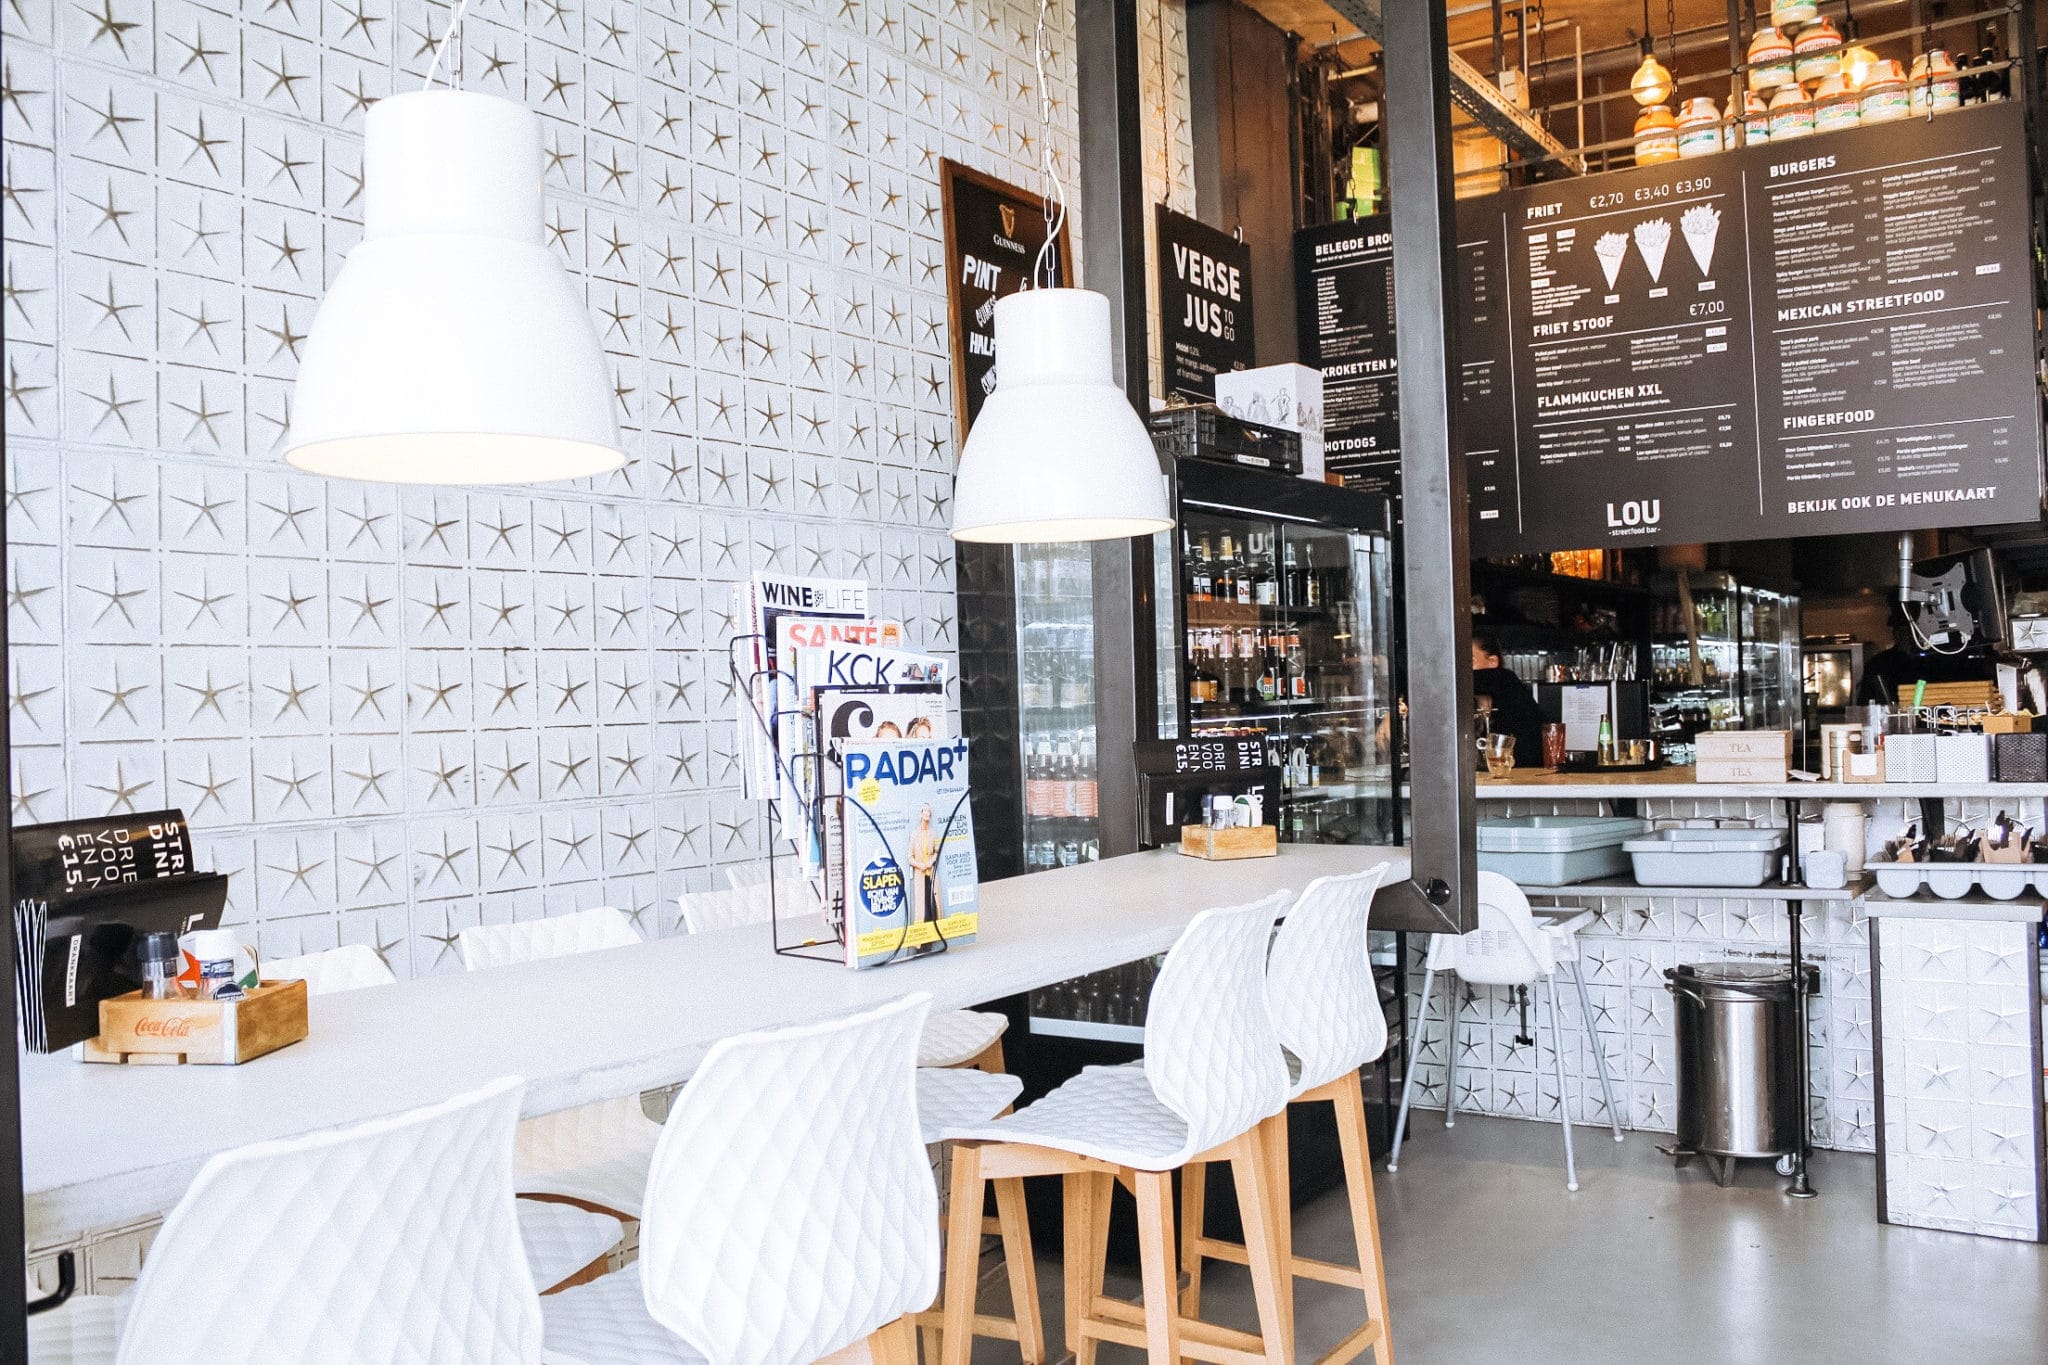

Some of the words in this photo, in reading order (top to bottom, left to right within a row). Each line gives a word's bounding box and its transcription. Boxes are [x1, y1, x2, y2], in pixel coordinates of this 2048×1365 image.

[1770, 156, 1836, 178] BURGERS
[1527, 203, 1562, 219] FRIET
[1590, 192, 1624, 209] €2,70
[1635, 185, 1669, 201] €3,40
[1676, 177, 1712, 194] €3,90
[993, 234, 1025, 254] GUINNESS
[1316, 238, 1364, 256] BELEGDE
[963, 254, 1001, 292] PINT
[1173, 242, 1241, 302] VERSE
[1184, 294, 1222, 338] JUS
[1224, 308, 1234, 325] TO
[1689, 300, 1724, 316] €7,00
[1778, 299, 1842, 322] MEXICAN
[1847, 289, 1945, 312] STREETFOOD
[1224, 326, 1235, 342] GO
[1533, 320, 1569, 338] FRIET
[1573, 316, 1614, 332] STOOF
[1322, 359, 1387, 378] KROKETTEN
[1538, 387, 1634, 408] FLAMMKUCHEN
[1638, 384, 1662, 397] XXL
[1783, 409, 1875, 429] FINGERFOOD
[1324, 437, 1377, 452] HOTDOGS
[1606, 499, 1661, 527] LOU
[1787, 498, 1837, 514] BEKIJK
[1841, 496, 1871, 510] OOK
[1876, 494, 1896, 507] DE
[1900, 486, 1996, 506] MENUKAART
[762, 581, 813, 607] WINE
[825, 588, 865, 610] LIFE
[789, 618, 878, 651] SANTÉ
[828, 650, 895, 686] KCK
[1201, 743, 1213, 770] VOO
[1213, 743, 1225, 771] DRIE
[1729, 743, 1752, 753] TEA
[1731, 767, 1753, 777] TEA
[77, 834, 98, 865] EN
[95, 829, 120, 882] VOO
[113, 828, 138, 883] DRIE
[57, 835, 84, 894] €15,
[135, 1016, 191, 1037] Coca-Cola
